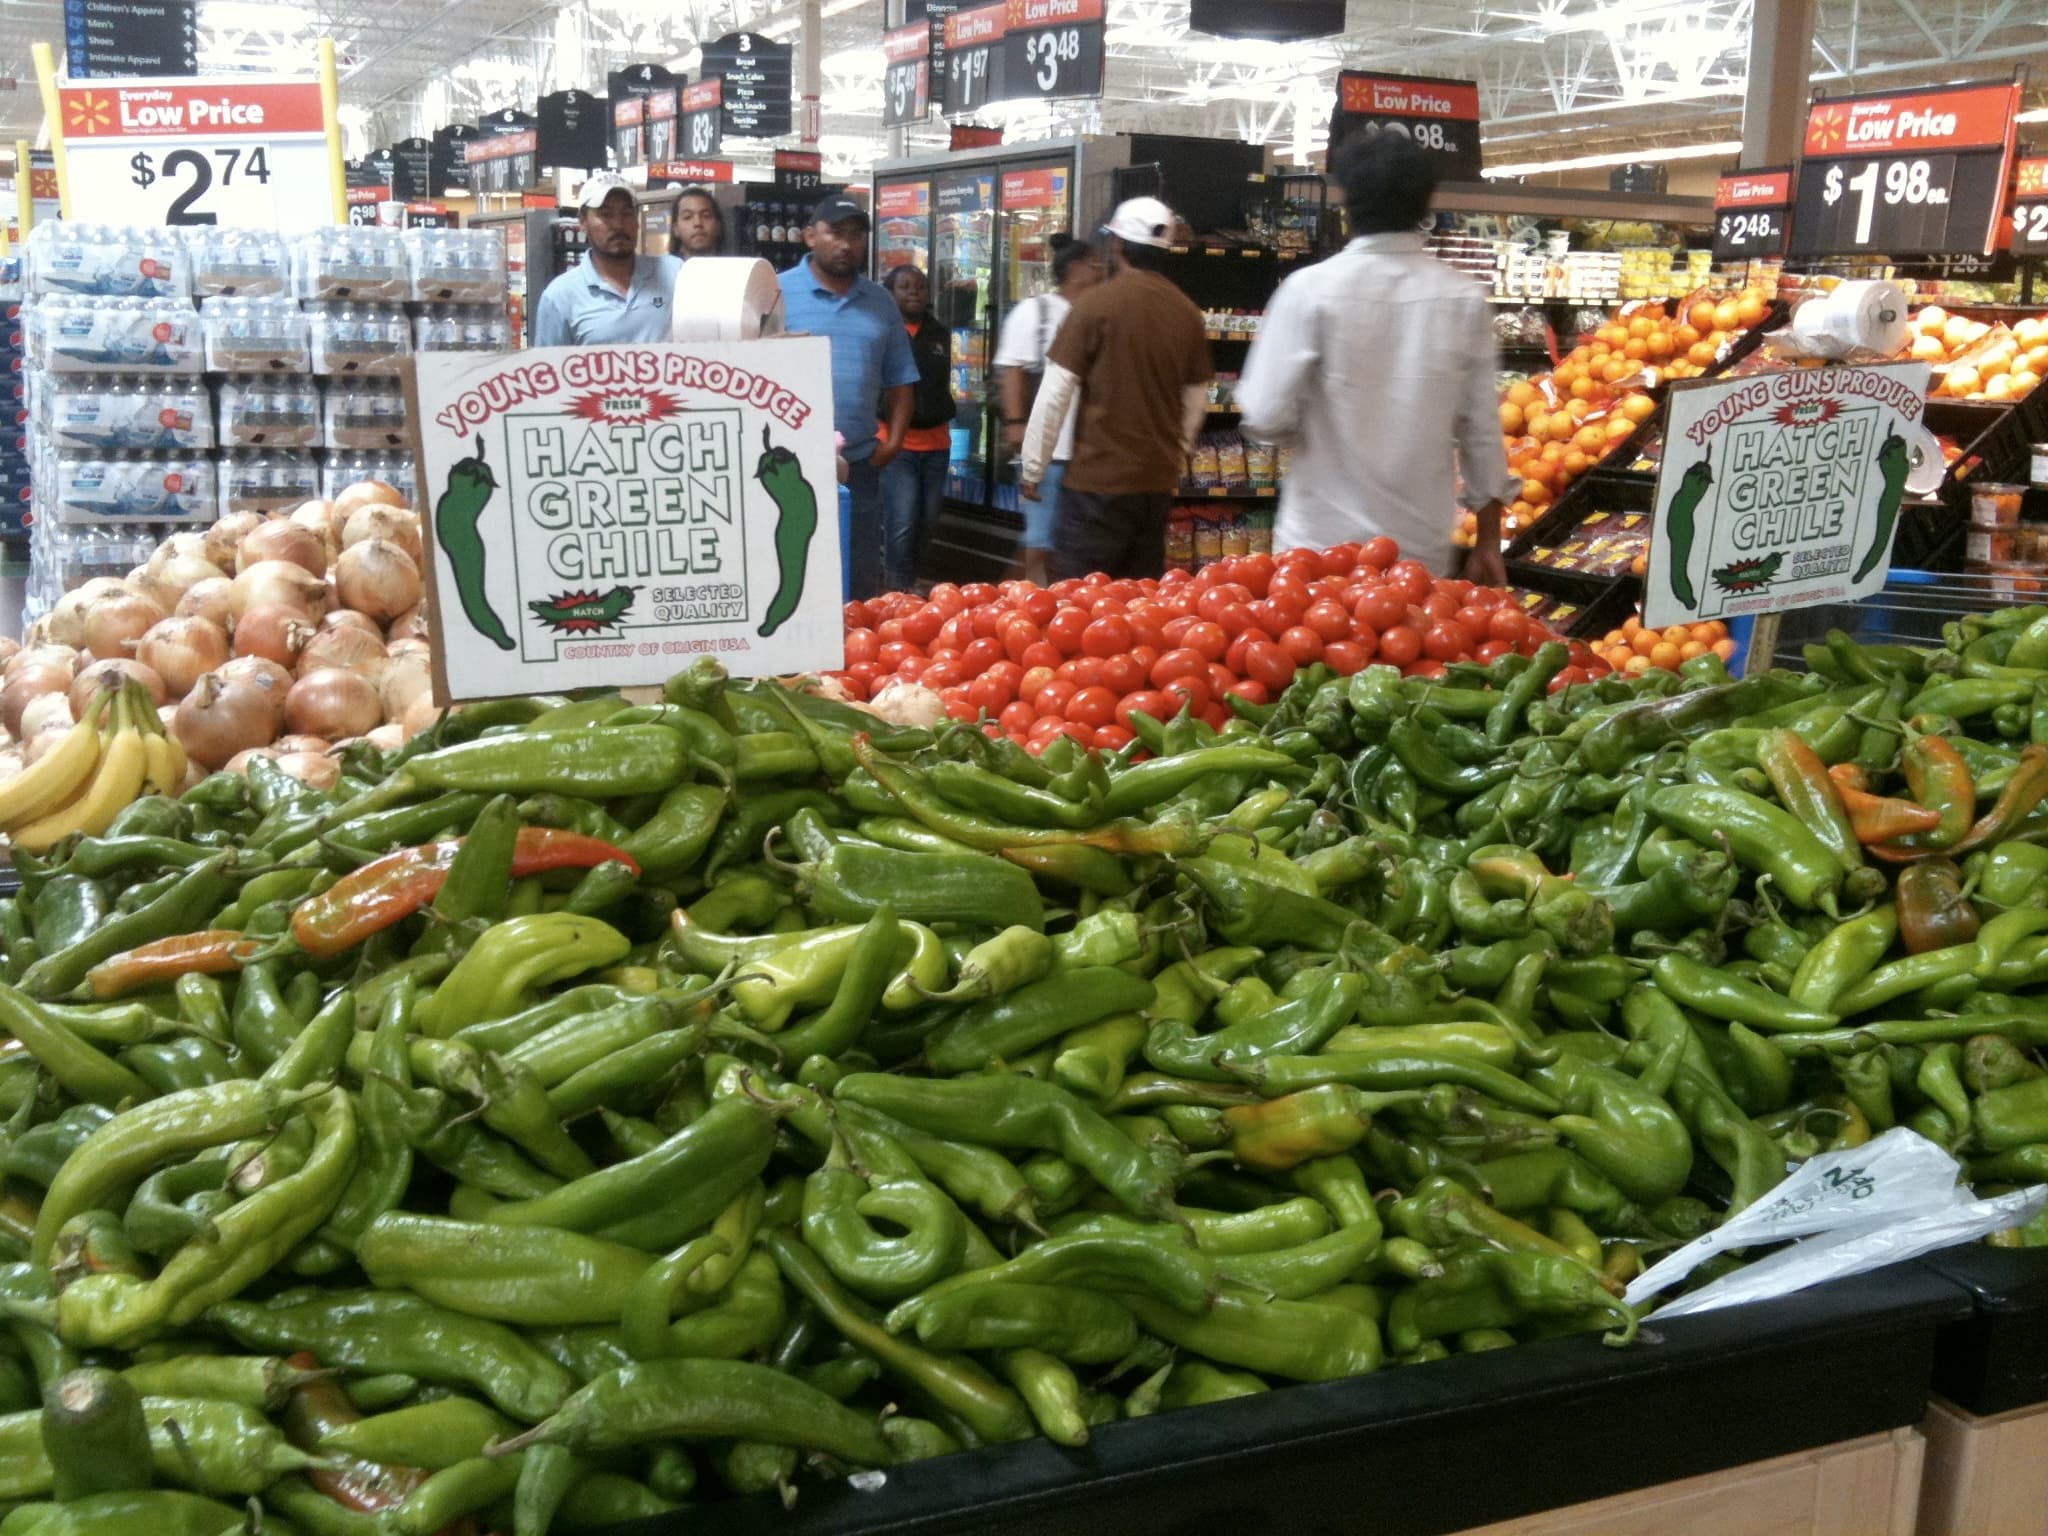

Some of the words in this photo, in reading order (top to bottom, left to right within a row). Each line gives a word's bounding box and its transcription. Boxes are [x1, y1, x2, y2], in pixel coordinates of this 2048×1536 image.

[131, 5, 165, 16] Apparel
[1025, 0, 1048, 19] Low
[1048, 0, 1078, 16] Price
[88, 20, 114, 29] Men's
[89, 36, 114, 46] Shoes
[739, 35, 751, 52] 3
[127, 54, 161, 66] Apparel
[641, 66, 652, 80] 4
[119, 89, 173, 103] Everyday
[567, 91, 576, 104] 5
[1374, 92, 1407, 111] Low
[1411, 94, 1451, 113] Price
[120, 101, 183, 127] Low
[189, 98, 264, 125] Price
[504, 110, 514, 122] 6
[1851, 104, 1892, 117] Everyday
[455, 126, 464, 136] 7
[1846, 117, 1895, 142] Low
[1896, 107, 1957, 139] Price
[414, 140, 422, 149] 8
[382, 149, 390, 159] 9
[350, 161, 361, 169] 10
[667, 166, 688, 175] Low
[1732, 185, 1751, 198] Low
[1751, 184, 1774, 196] Price
[436, 361, 560, 438] YOUNG
[562, 350, 662, 388] GUNS
[664, 352, 811, 430] PRODUCE
[604, 398, 642, 411] FRESH
[1686, 382, 1769, 446] YOUNG
[1773, 370, 1837, 400] GUNS
[1837, 369, 1923, 421] PRODUCE
[523, 421, 730, 478] HATCH
[1733, 417, 1868, 472] HATCH
[1728, 459, 1861, 513] GREEN
[528, 473, 732, 530] GREEN
[1732, 501, 1844, 551] CHILE
[547, 528, 722, 580] CHILE
[1792, 545, 1850, 565] SELECTED
[1791, 558, 1849, 578] QUALITY
[652, 584, 743, 603] SELECTED
[572, 607, 605, 617] HATCH
[654, 601, 743, 622] QUALITY
[565, 644, 635, 660] COUNTRY
[638, 643, 659, 656] OF
[663, 640, 717, 655] ORIGIN
[719, 637, 751, 651] USA
